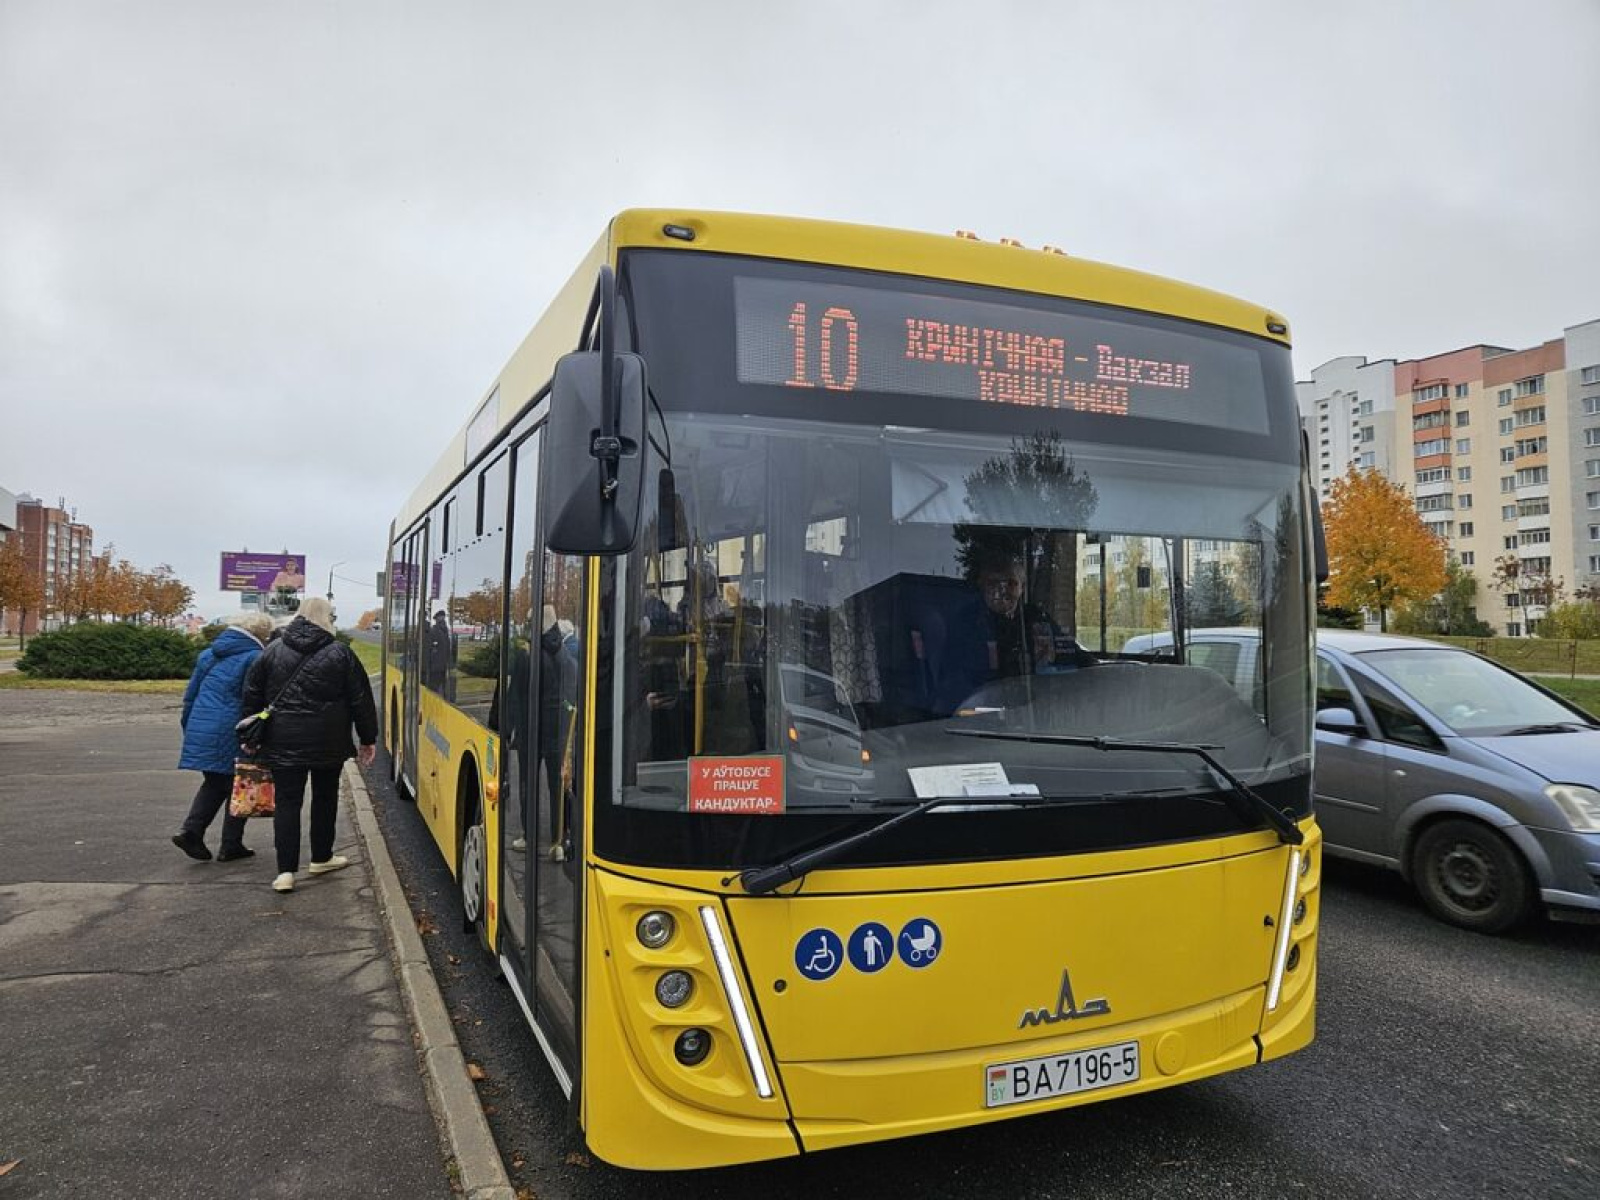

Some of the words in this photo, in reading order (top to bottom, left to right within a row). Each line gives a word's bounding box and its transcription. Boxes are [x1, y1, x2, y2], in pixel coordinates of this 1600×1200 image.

[785, 302, 858, 391] 10
[906, 318, 1065, 375] КРЫНІЧНАЯ
[702, 768, 710, 778] У
[712, 765, 771, 778] АЎТОБУСЕ
[713, 779, 759, 792] ПРАЦУЕ
[991, 1087, 1006, 1101] BY
[1013, 1047, 1136, 1098] BA7196-5
